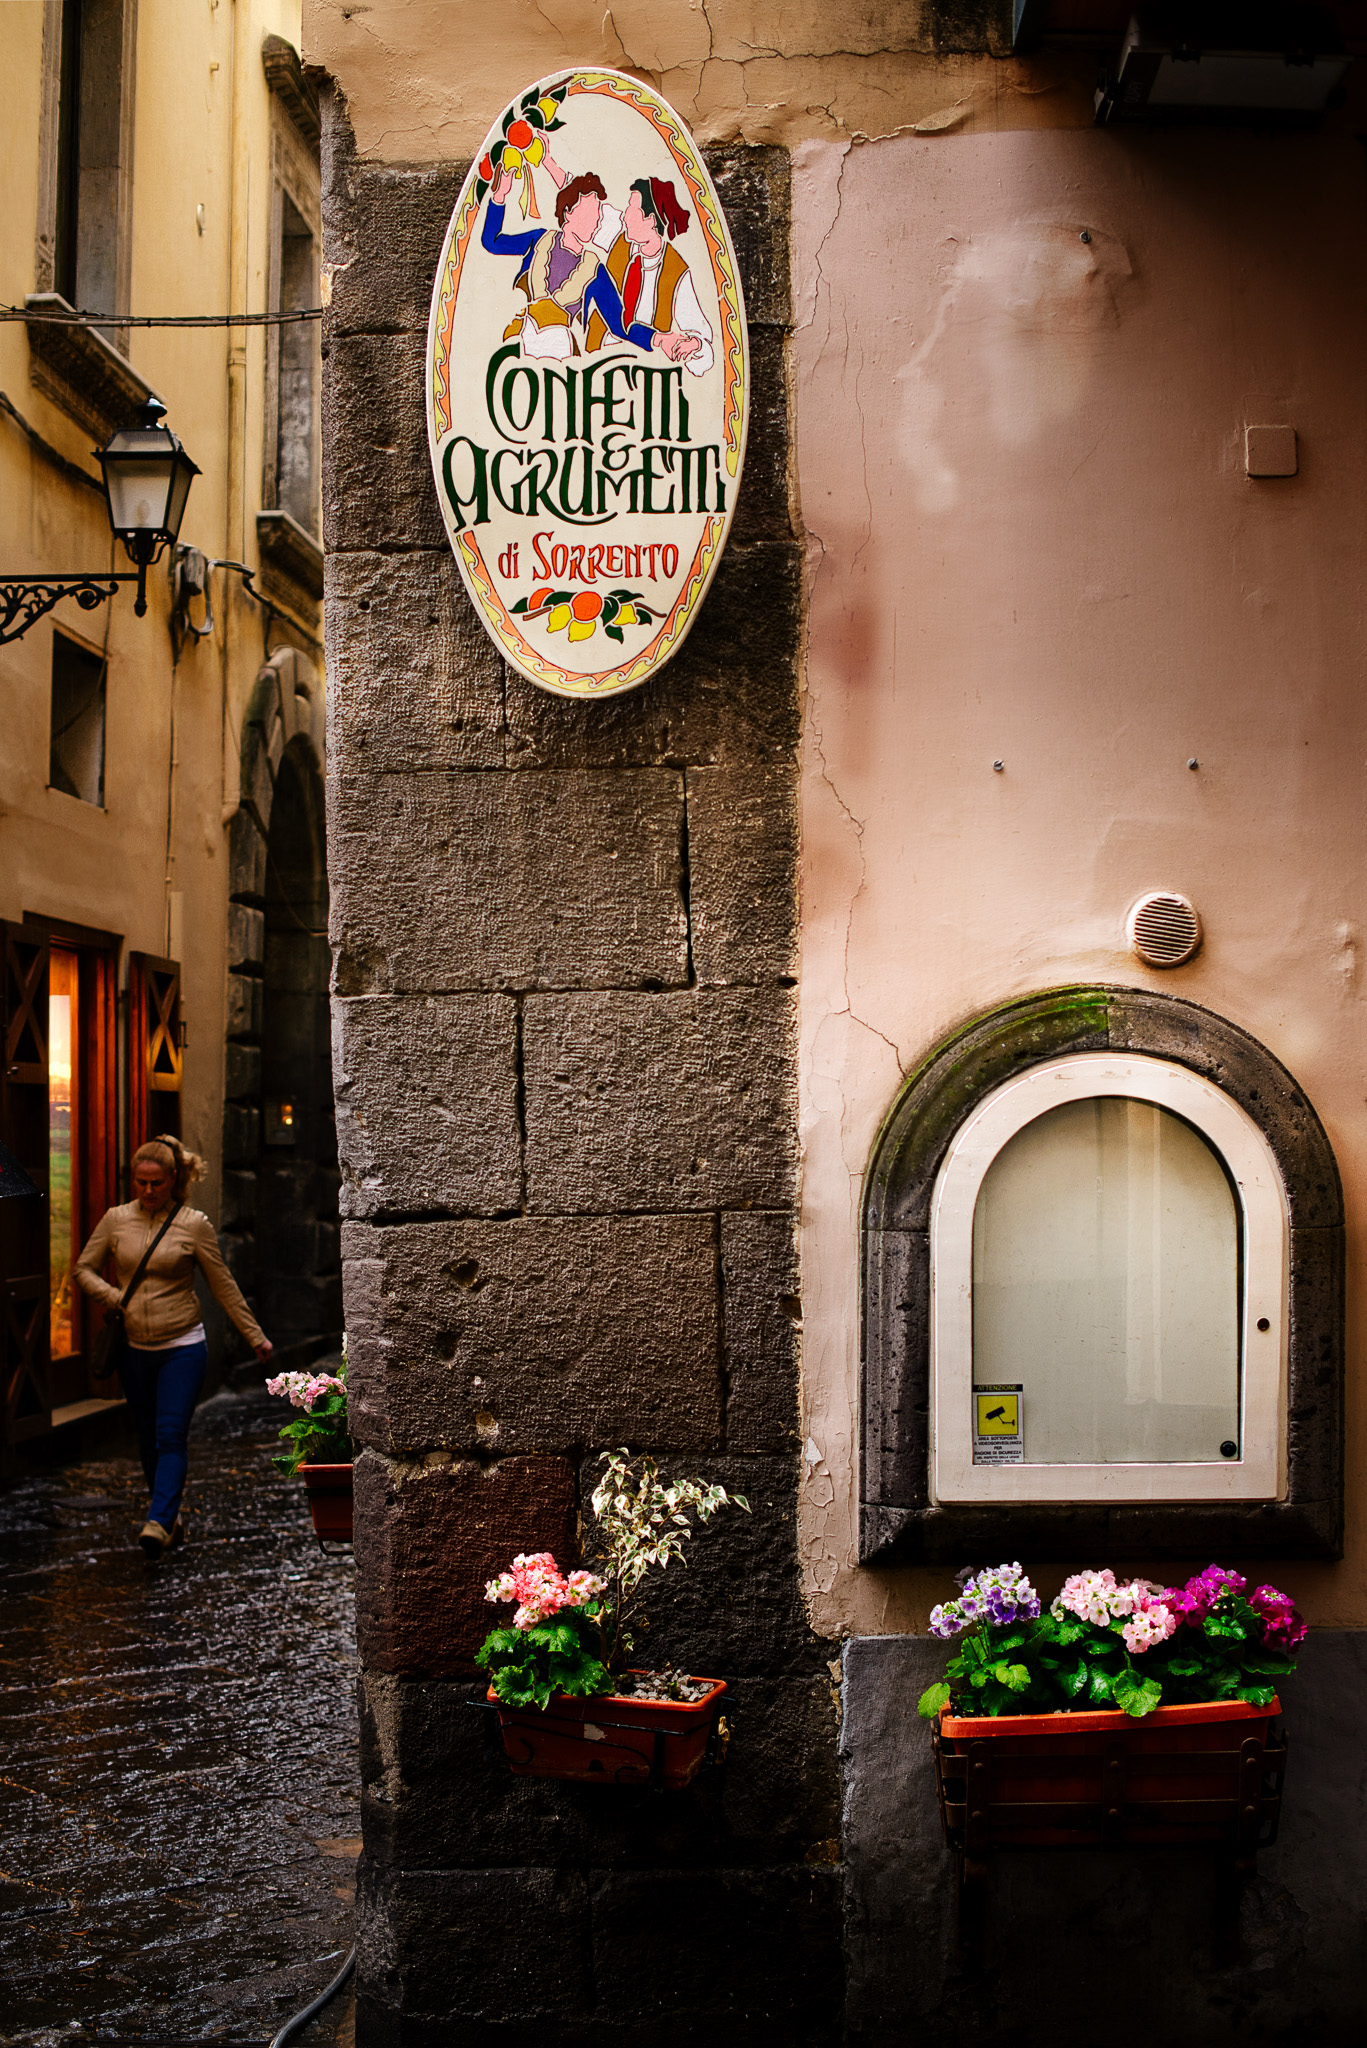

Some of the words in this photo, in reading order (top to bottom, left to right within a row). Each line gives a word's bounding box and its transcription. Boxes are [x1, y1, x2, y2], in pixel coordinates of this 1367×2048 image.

[485, 341, 692, 446] CONFETTI
[442, 436, 727, 533] AGRUMETTI
[601, 432, 637, 471] &
[498, 542, 520, 580] di
